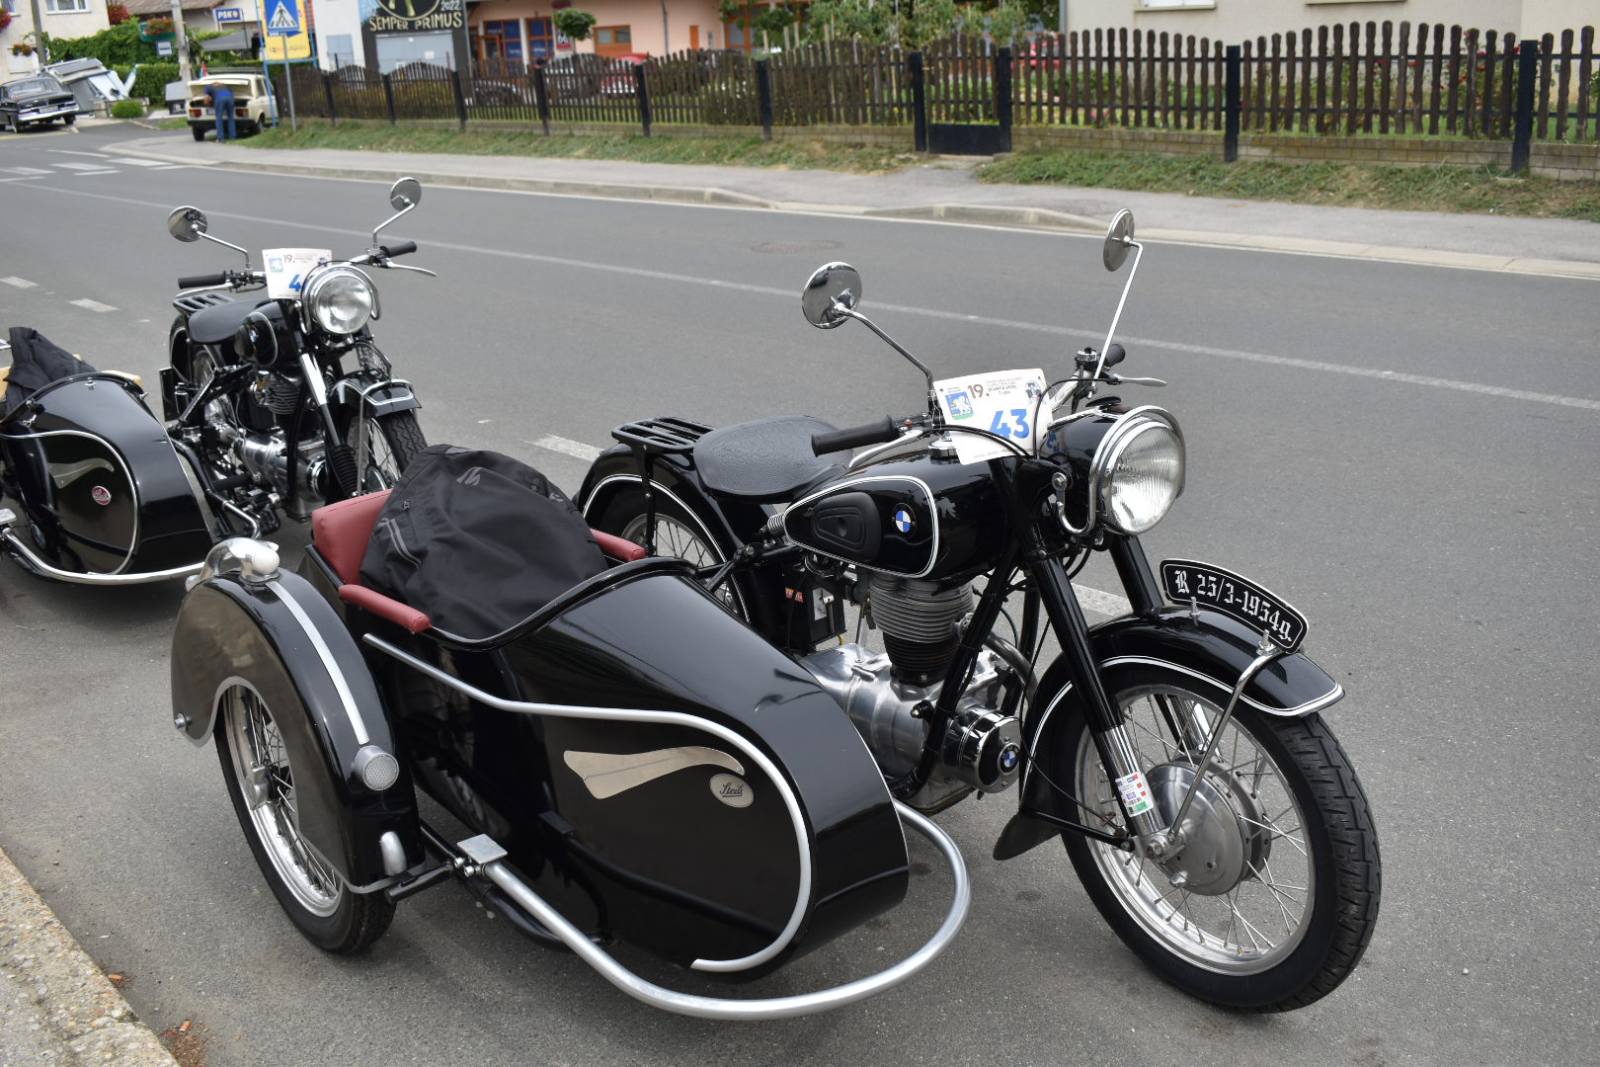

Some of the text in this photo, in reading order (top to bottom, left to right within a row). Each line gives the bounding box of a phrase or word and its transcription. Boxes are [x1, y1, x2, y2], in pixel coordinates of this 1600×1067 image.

[369, 12, 462, 31] SEMPER PRIMUS
[989, 409, 1030, 439] 43
